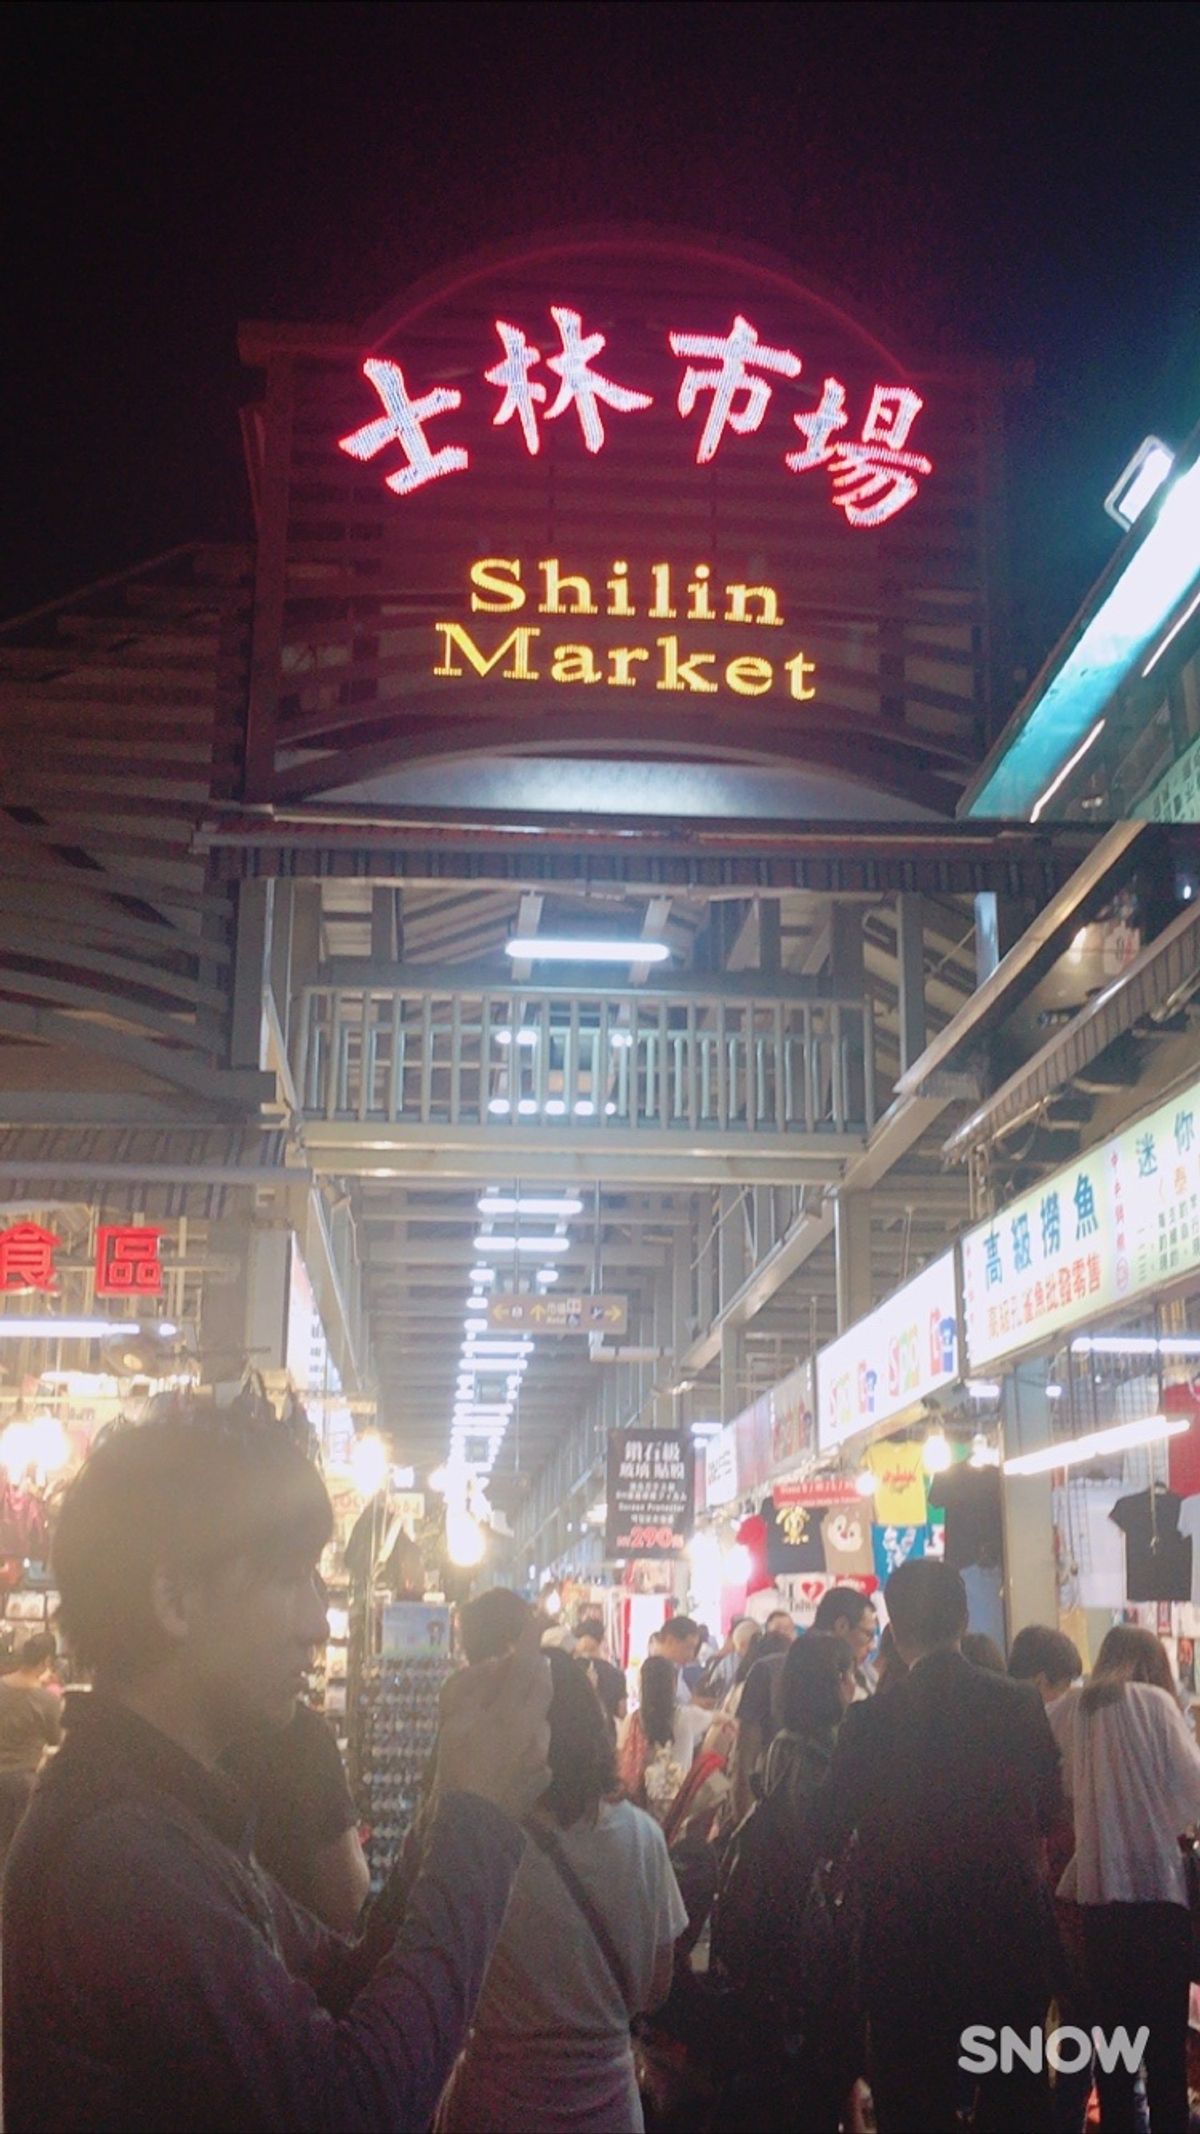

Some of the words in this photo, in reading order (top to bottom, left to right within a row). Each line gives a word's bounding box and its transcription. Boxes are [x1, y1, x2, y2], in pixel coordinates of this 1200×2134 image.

[338, 306, 932, 527] 士林市場
[469, 558, 785, 625] Shilin
[433, 623, 816, 700] Market
